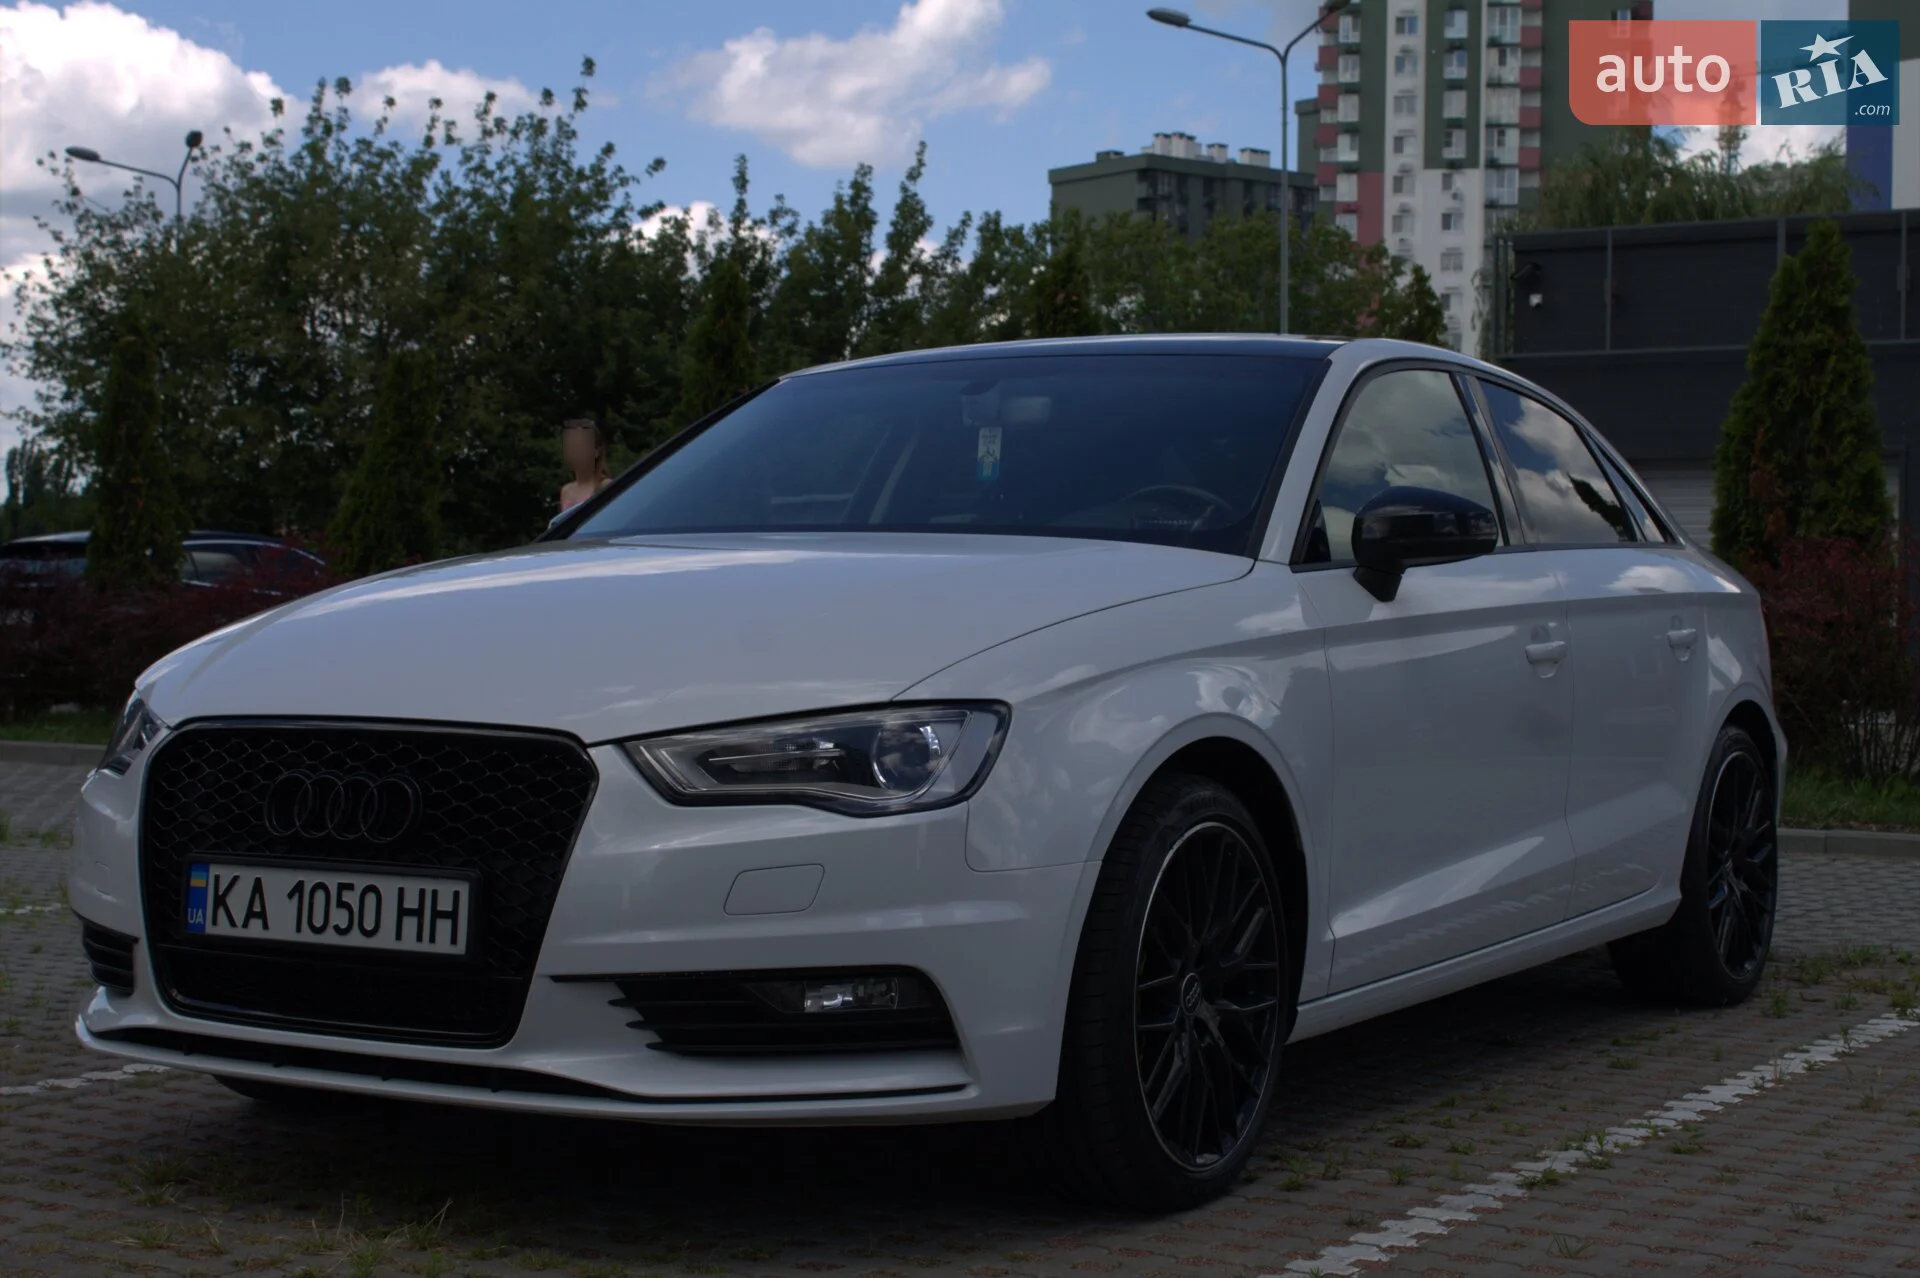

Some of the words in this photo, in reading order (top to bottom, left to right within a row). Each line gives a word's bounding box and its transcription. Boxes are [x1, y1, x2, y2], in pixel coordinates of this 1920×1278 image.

[187, 907, 204, 925] UA
[211, 873, 270, 931] KA
[287, 879, 383, 938] 1050
[395, 886, 461, 946] HH
